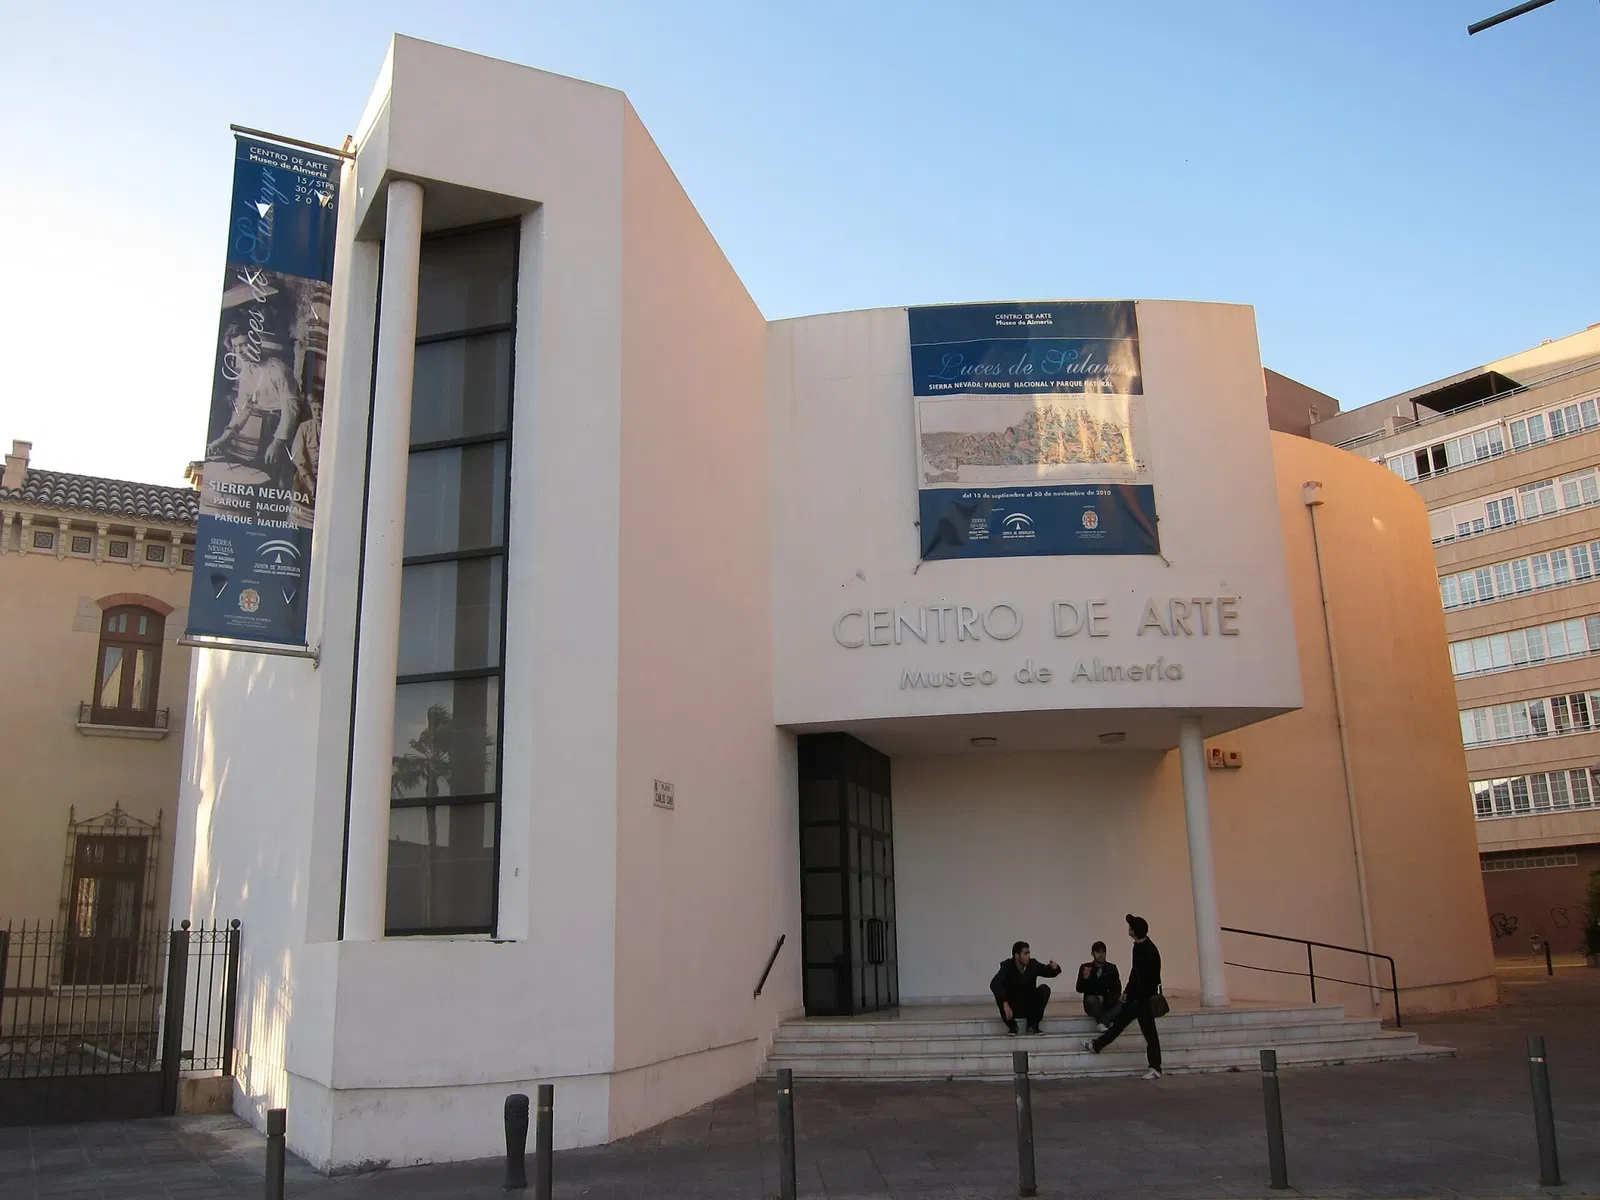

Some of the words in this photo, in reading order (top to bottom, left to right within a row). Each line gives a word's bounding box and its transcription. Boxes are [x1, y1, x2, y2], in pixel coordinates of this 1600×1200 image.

[249, 146, 288, 161] CENTRO
[291, 157, 304, 166] DE
[305, 161, 328, 171] ARTE
[249, 153, 278, 166] Museo
[280, 162, 292, 170] de
[927, 352, 1003, 380] Luces
[1008, 352, 1034, 376] de
[928, 383, 953, 391] SIERRA
[954, 381, 984, 389] NEVADA:
[984, 381, 1011, 390] PARQUE
[1014, 381, 1049, 389] NACIONAL
[1056, 380, 1083, 388] PARQUE
[1084, 380, 1114, 388] NATURAL
[208, 480, 255, 497] SIERRA
[258, 487, 310, 504] NEVADA
[991, 491, 1025, 500] septiembre
[213, 496, 251, 509] PARQUE
[256, 502, 303, 516] NACIONAL
[214, 512, 252, 525] PARQUE
[257, 518, 300, 531] NATURAL
[832, 603, 1023, 649] CENTRO
[1052, 599, 1110, 639] DE
[1136, 596, 1240, 638] ARTE
[899, 667, 997, 690] Museo
[1014, 659, 1054, 685] de
[1071, 656, 1184, 684] Almería
